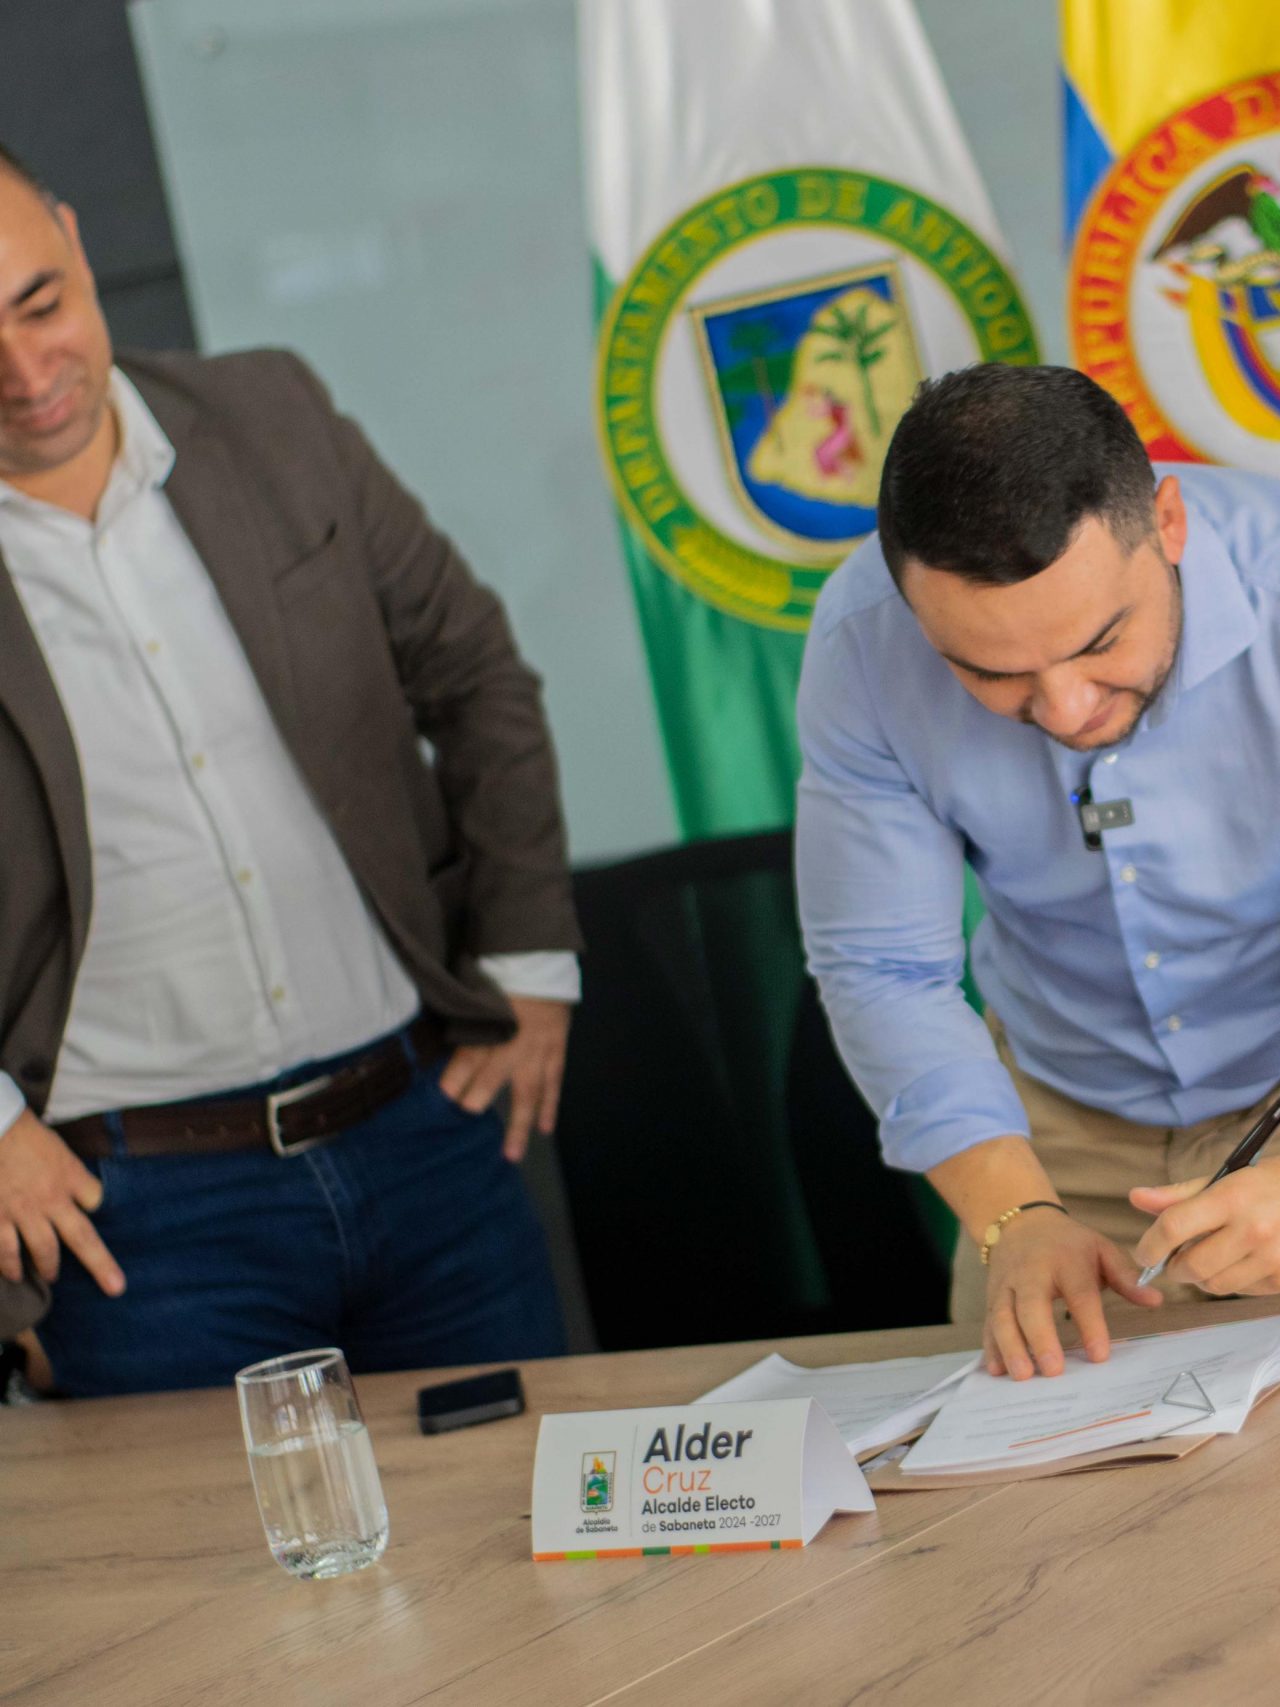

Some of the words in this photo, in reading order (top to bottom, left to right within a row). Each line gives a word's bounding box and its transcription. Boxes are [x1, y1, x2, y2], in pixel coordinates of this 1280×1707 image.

[606, 183, 780, 523] DEPARTAMENTO
[796, 176, 868, 220] DE
[883, 199, 1032, 366] ANTIOQ
[642, 1421, 754, 1463] Alder
[642, 1465, 712, 1495] Cruz
[641, 1497, 701, 1515] Alcalde
[705, 1494, 756, 1512] Electo
[641, 1521, 657, 1533] de
[659, 1518, 717, 1532] Sabaneta
[718, 1516, 747, 1529] 2024
